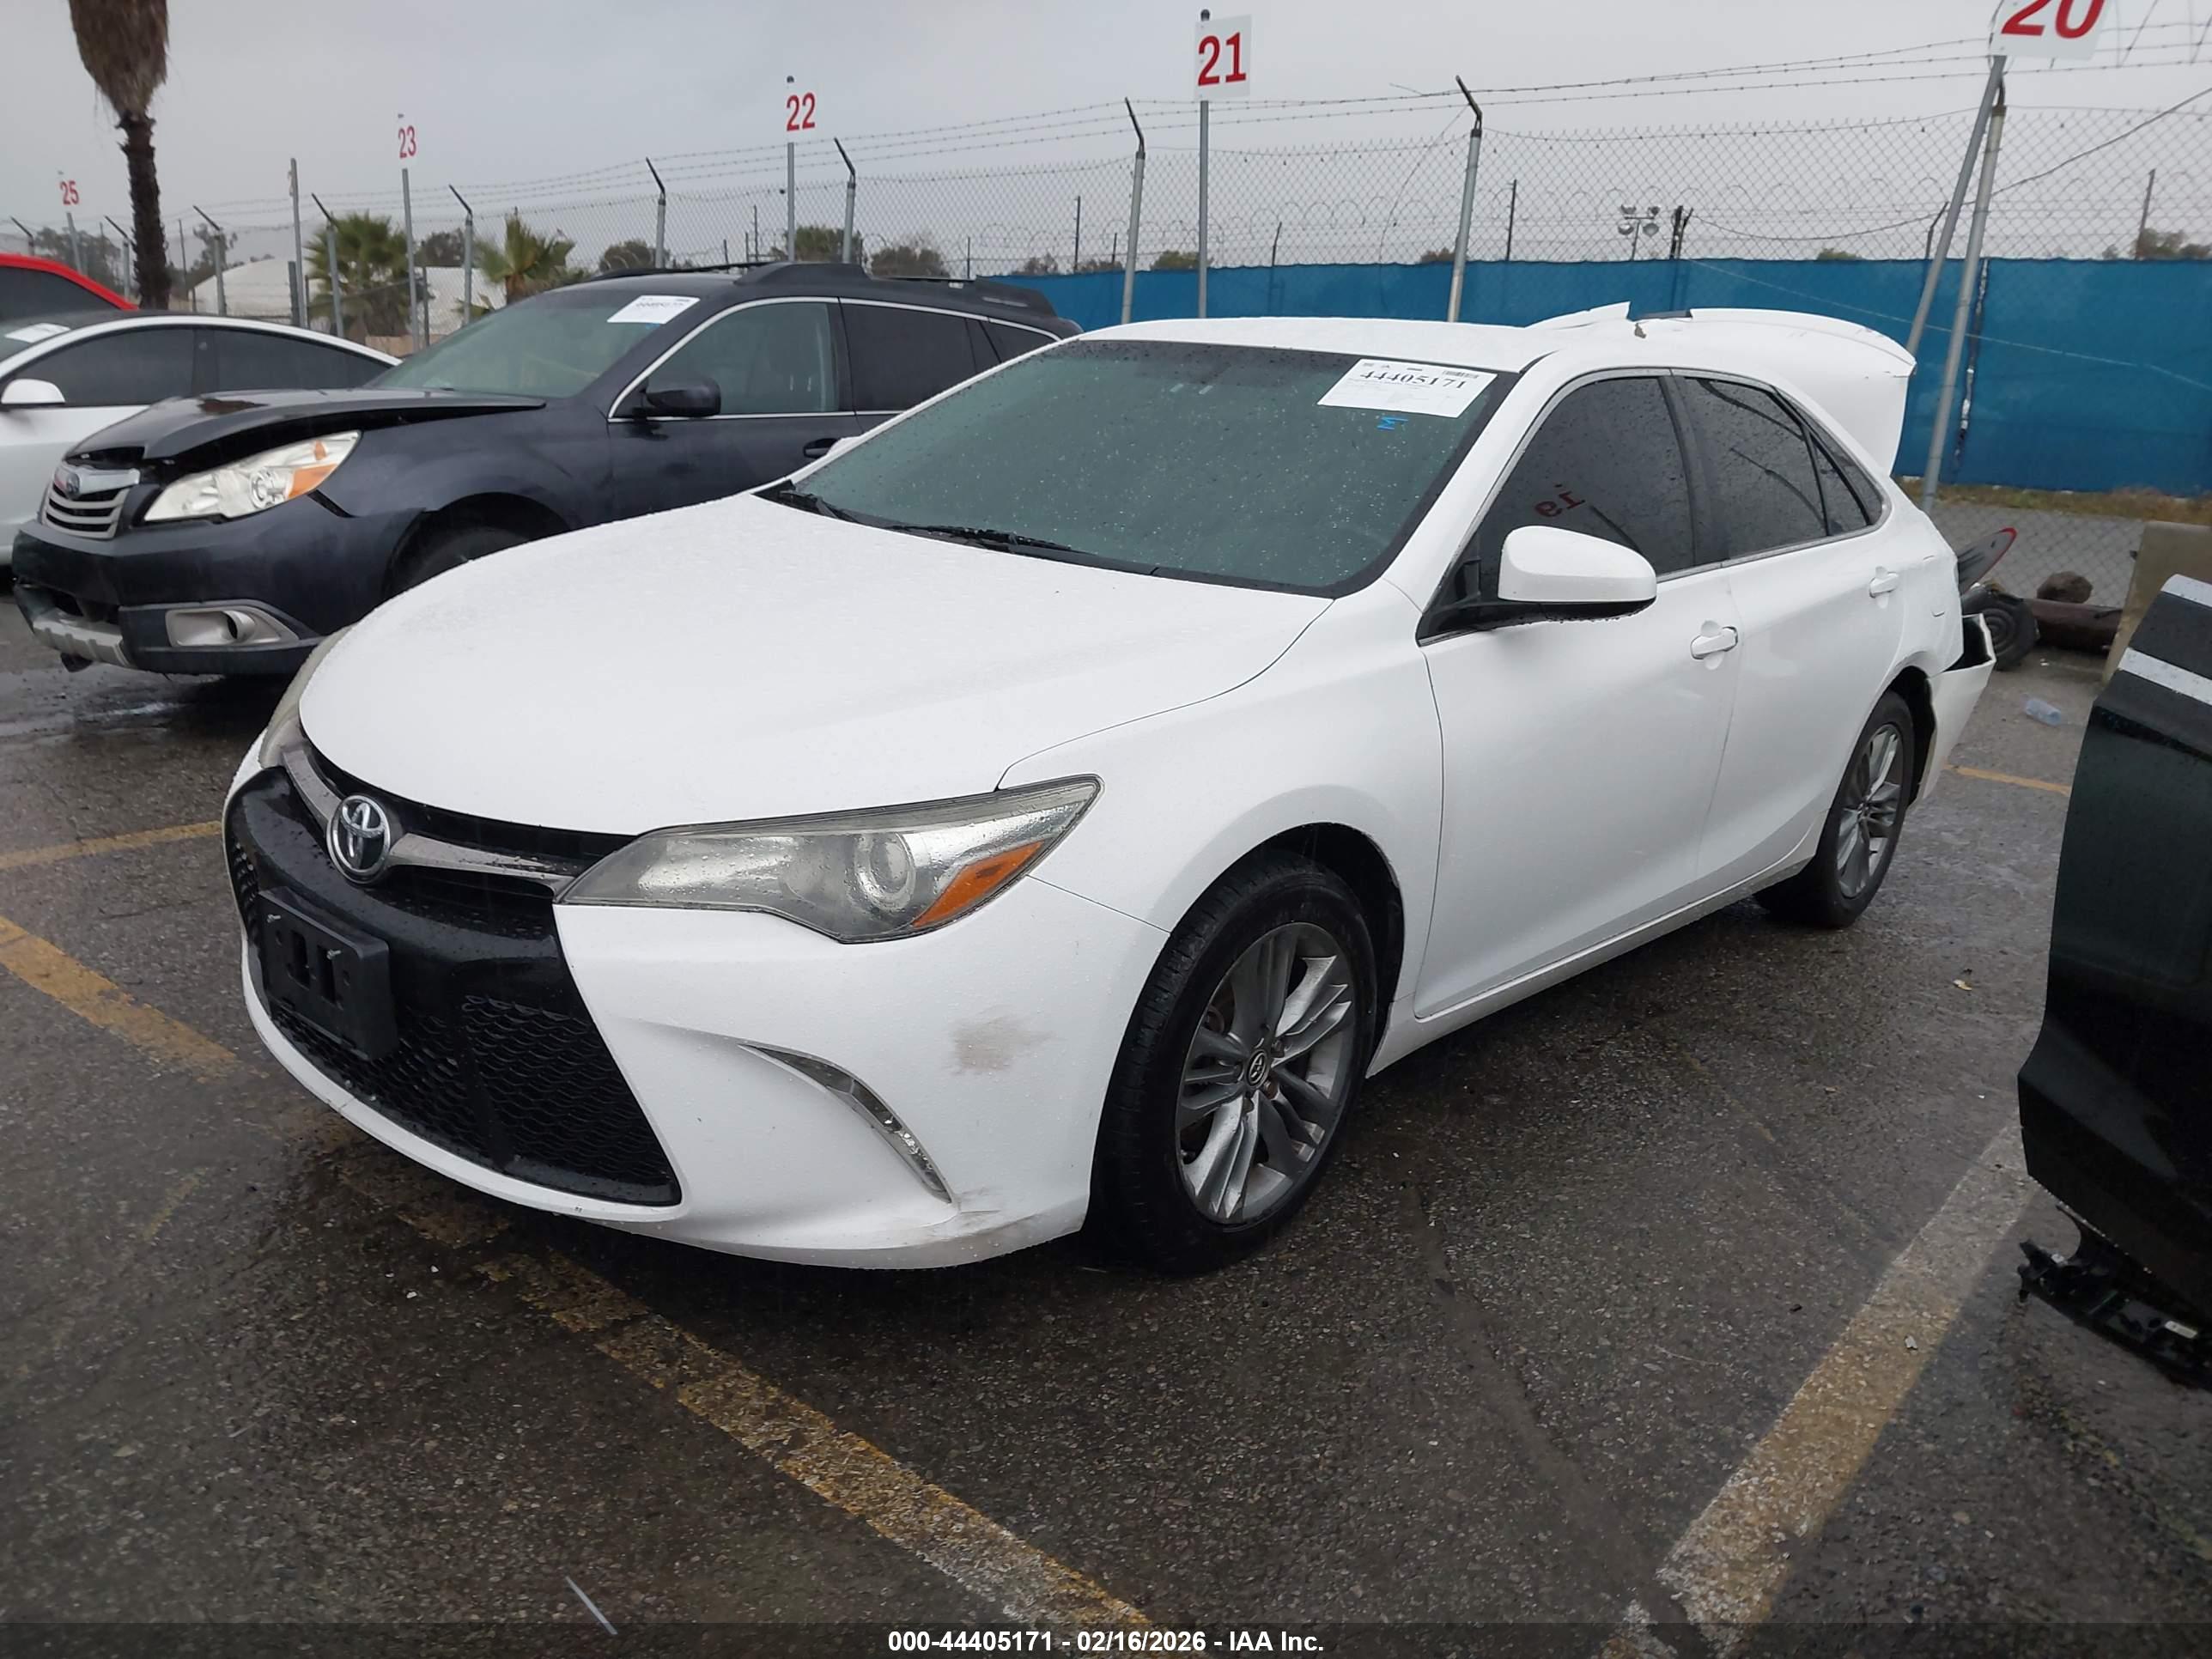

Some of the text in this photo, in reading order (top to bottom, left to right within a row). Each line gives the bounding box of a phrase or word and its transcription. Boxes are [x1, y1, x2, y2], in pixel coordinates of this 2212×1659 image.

[1197, 32, 1248, 87] 21
[786, 92, 816, 132] 22
[398, 125, 416, 159] 23
[59, 180, 79, 205] 25
[1359, 370, 1467, 389] 44405171
